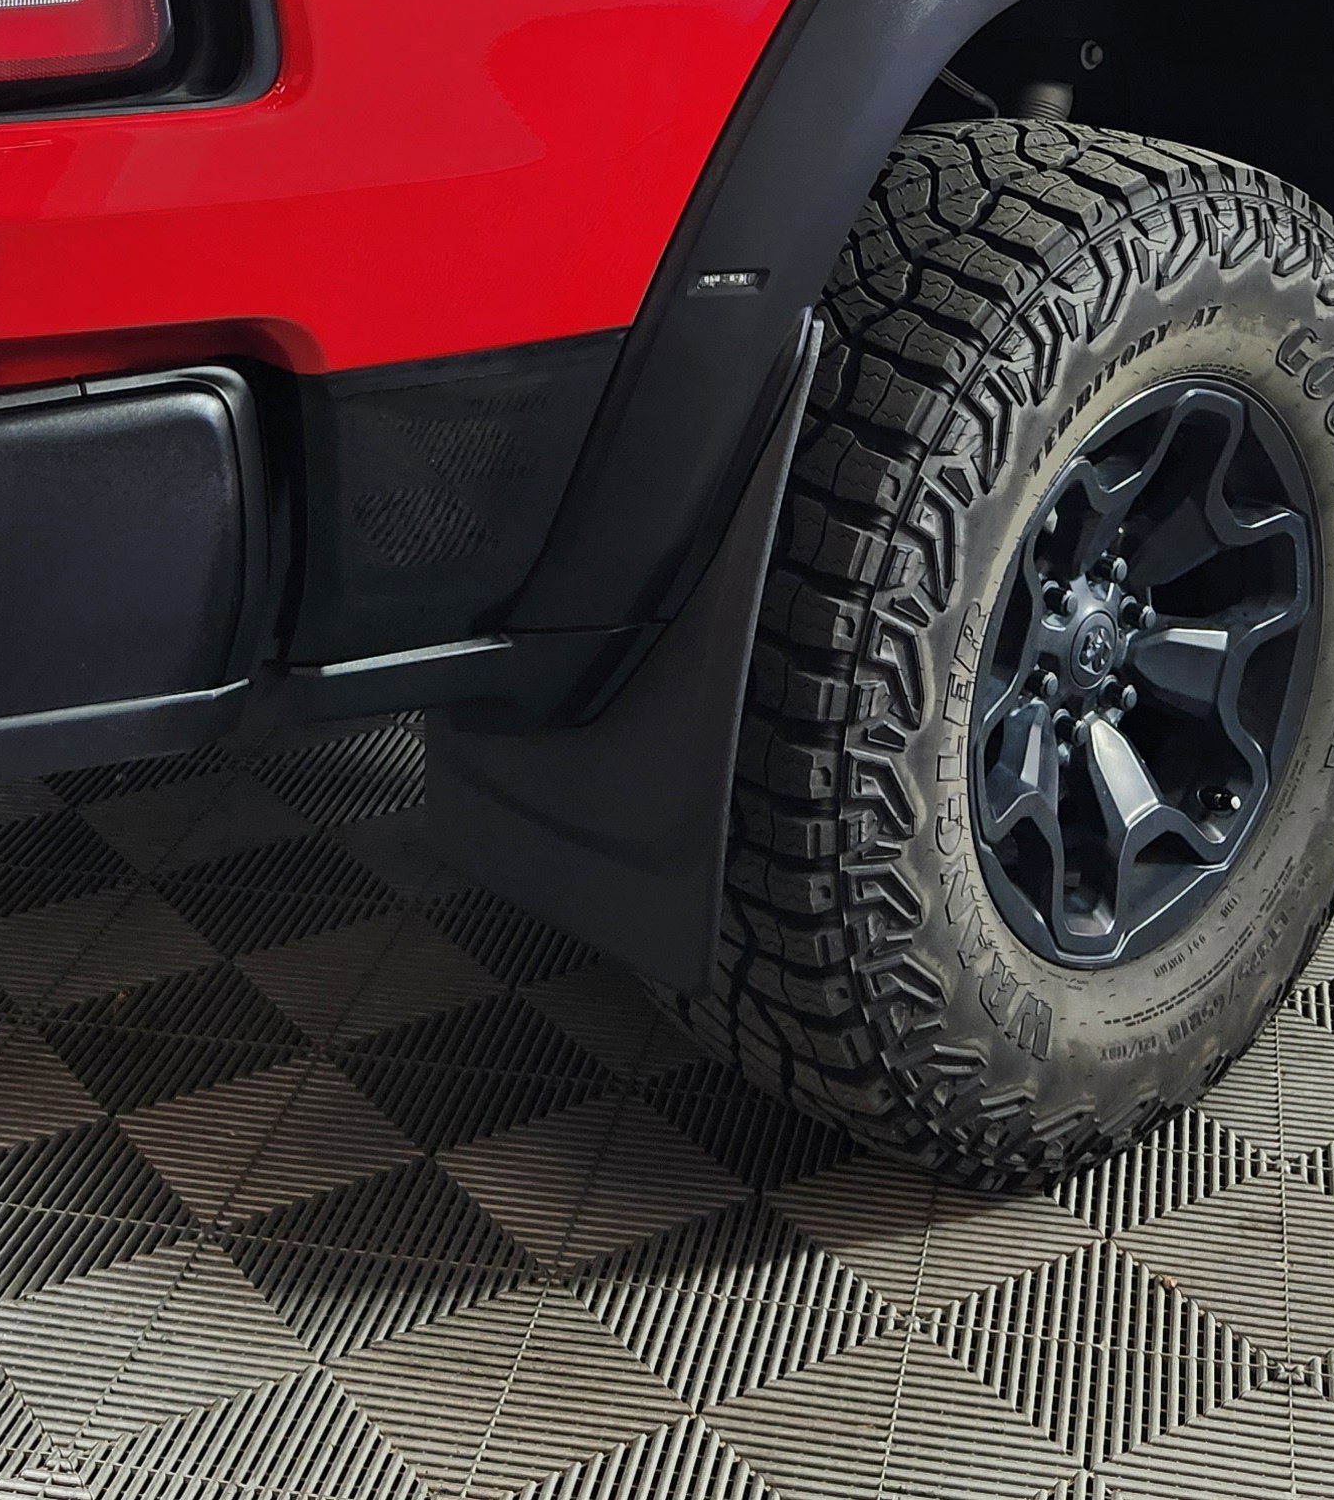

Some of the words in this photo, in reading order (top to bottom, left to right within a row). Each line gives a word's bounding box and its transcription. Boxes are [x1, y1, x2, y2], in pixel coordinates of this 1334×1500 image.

[1028, 320, 1172, 477] TERRITORY
[1185, 305, 1222, 332] AT
[936, 600, 1052, 1062] WRANGLER
